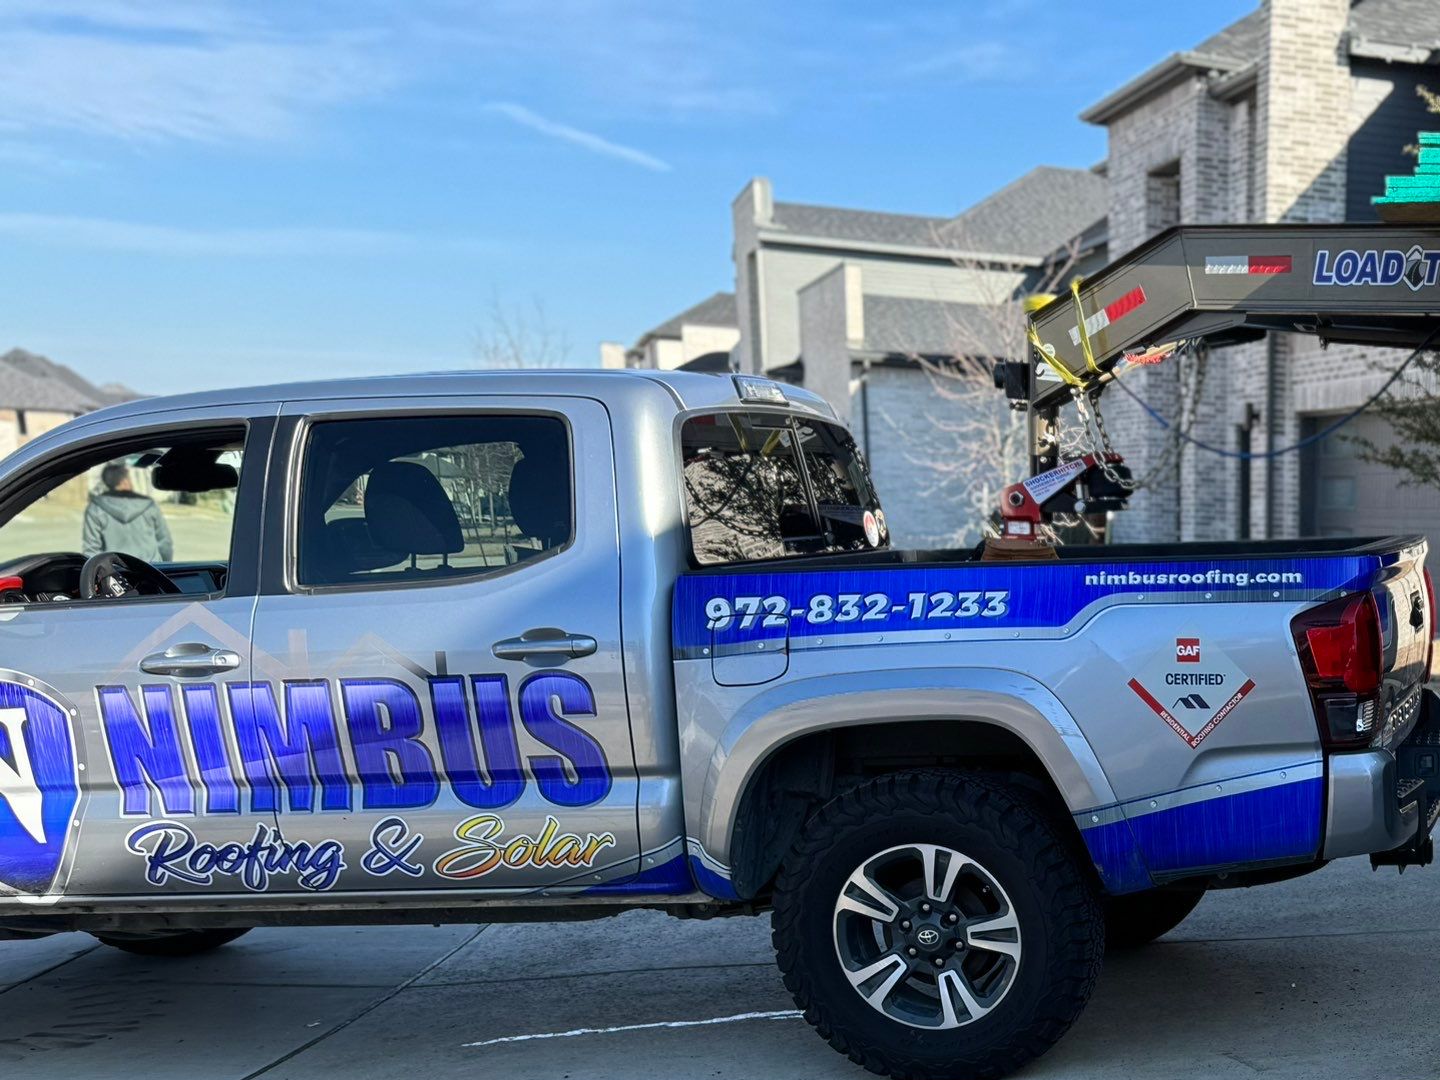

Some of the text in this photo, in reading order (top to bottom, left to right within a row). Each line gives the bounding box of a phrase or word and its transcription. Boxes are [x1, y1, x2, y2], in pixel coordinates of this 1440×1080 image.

[1312, 250, 1406, 286] LOAD
[1085, 568, 1303, 587] nimbusroofing.com
[705, 590, 1010, 631] 972-832-1233
[1176, 645, 1200, 656] GAF
[1165, 672, 1224, 686] CERTIFIED
[1160, 710, 1190, 741] RESIDENTIAL
[96, 669, 613, 818] NIMBUS
[127, 813, 618, 891] Roofing & Solar
